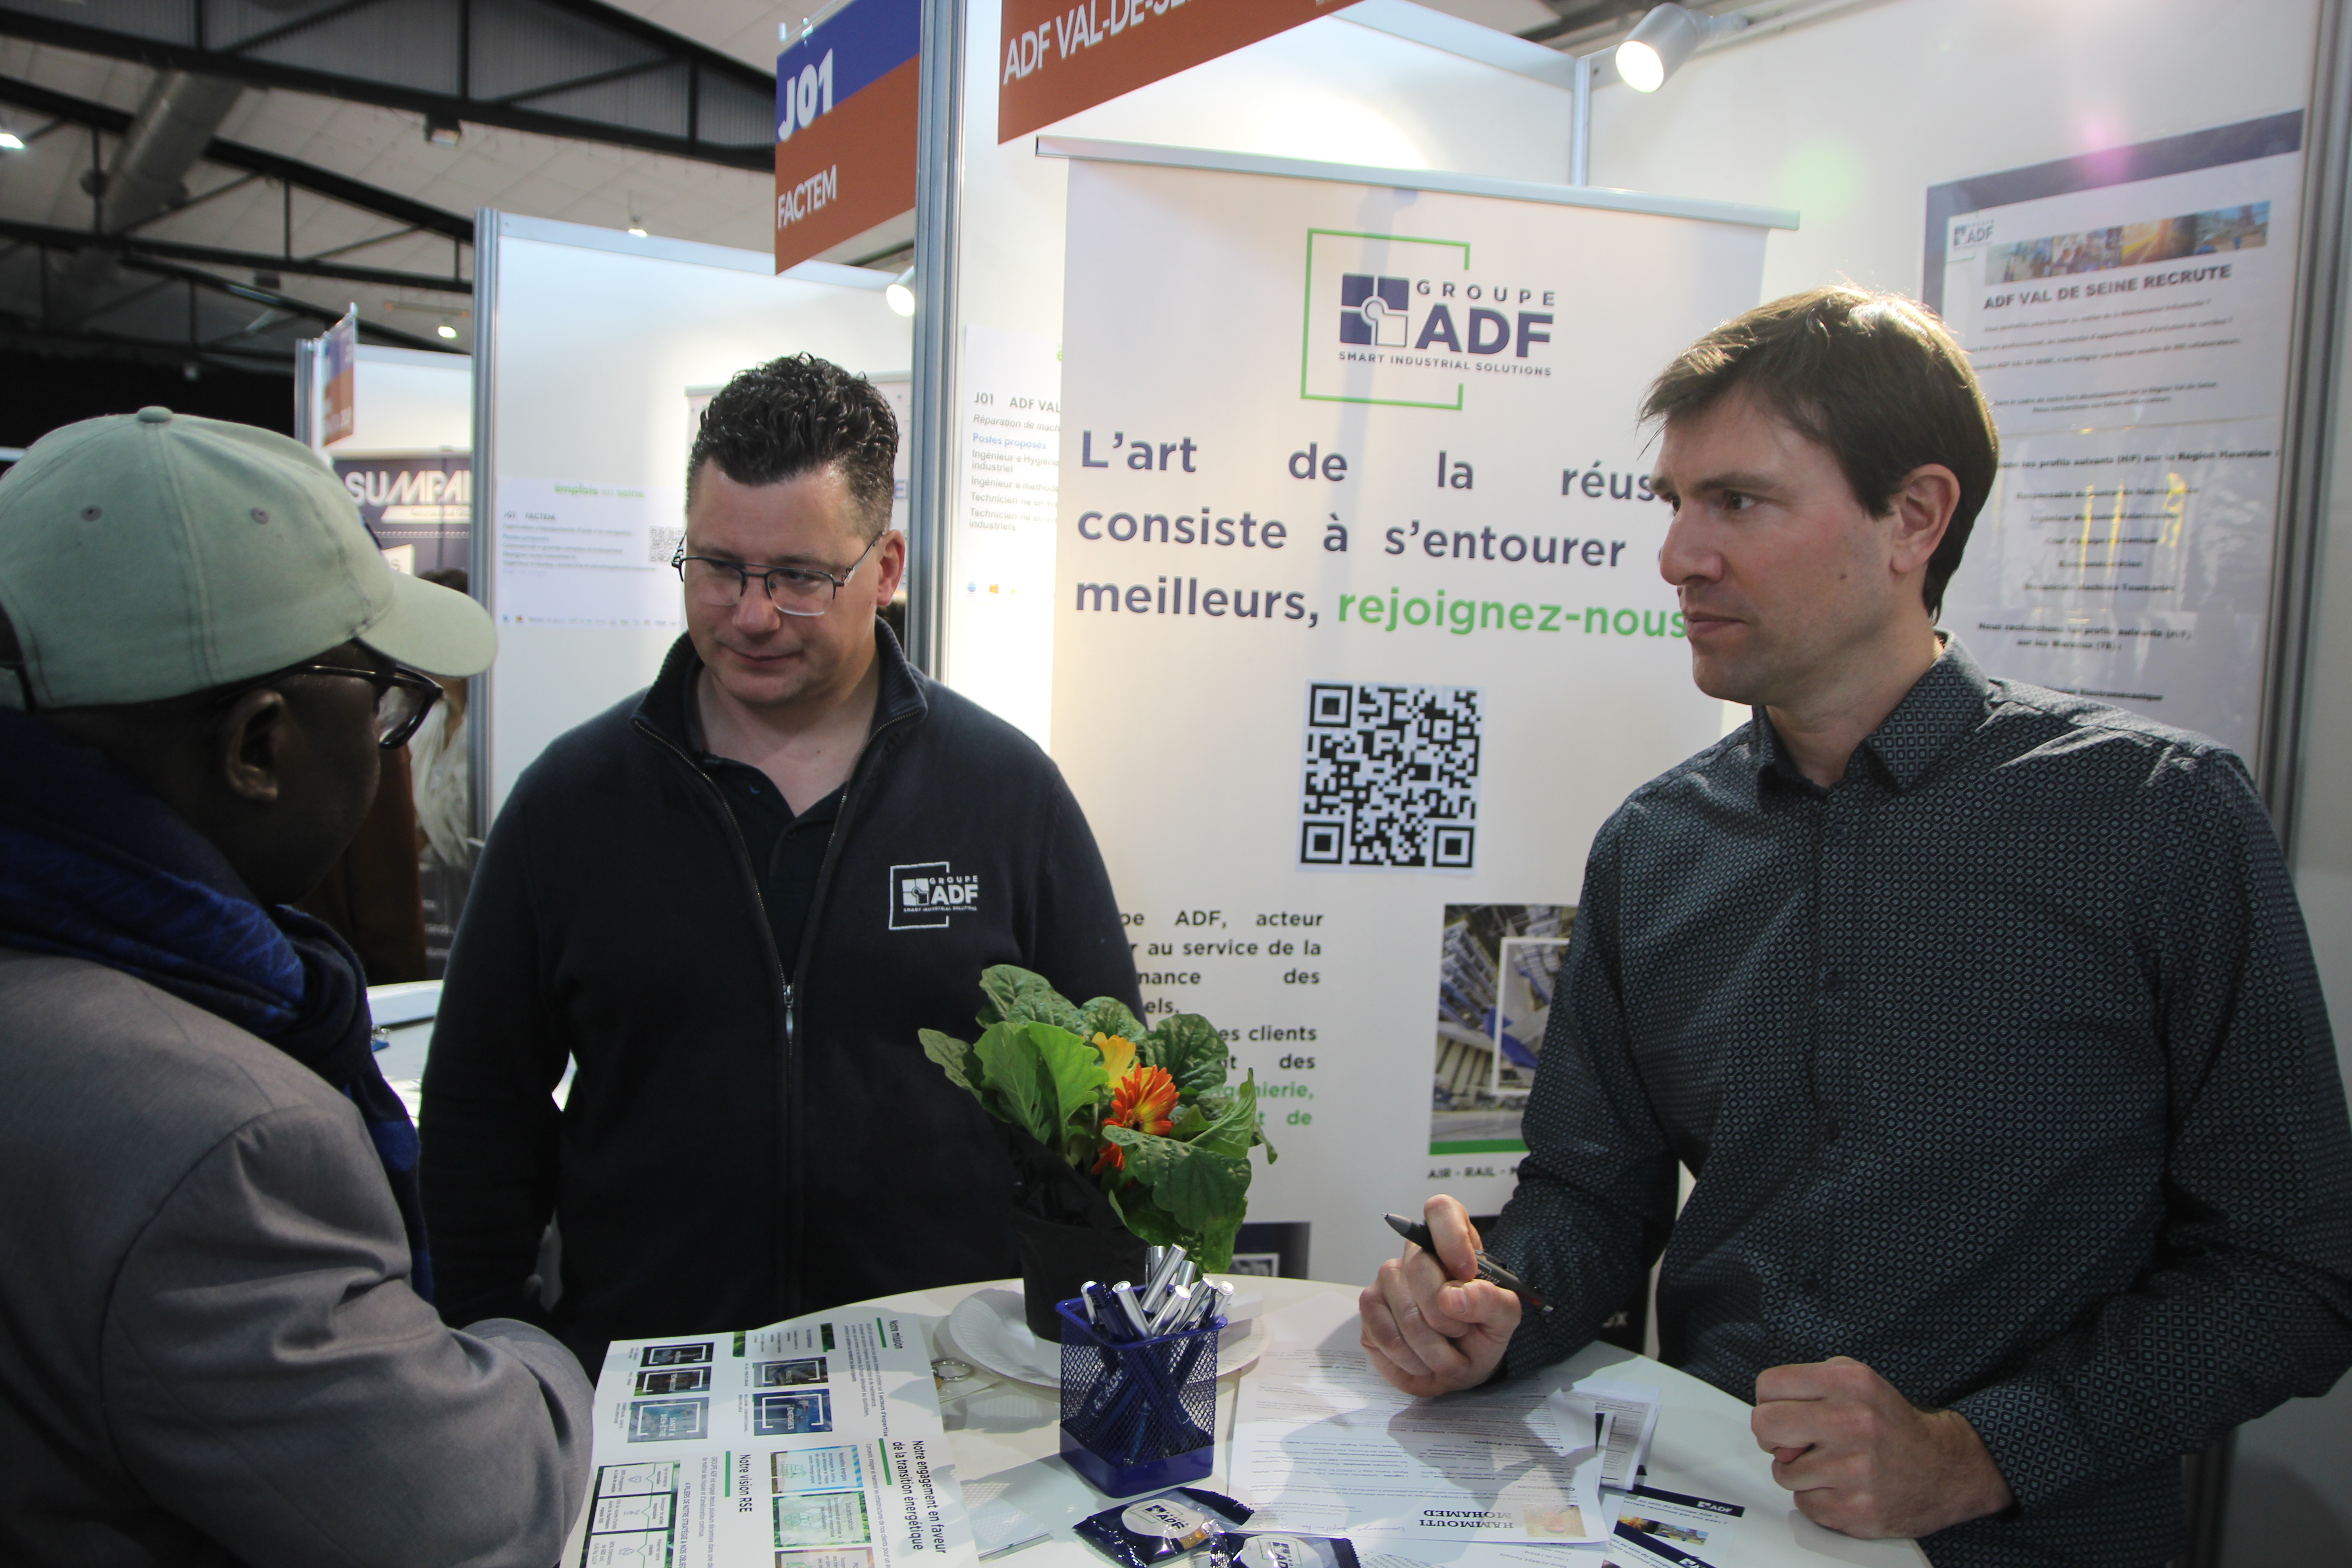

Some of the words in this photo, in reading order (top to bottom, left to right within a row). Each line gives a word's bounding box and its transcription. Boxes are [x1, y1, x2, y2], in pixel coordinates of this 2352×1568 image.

[1003, 20, 1051, 84] ADF
[1056, 0, 1192, 59] VAL-DE-
[778, 48, 833, 142] J01
[777, 164, 836, 230] FACTEM
[1967, 224, 1994, 244] ADF
[1416, 279, 1555, 306] GROUPE
[1983, 294, 2016, 309] ADF
[2019, 289, 2052, 304] VAL
[2058, 285, 2081, 300] DE
[2086, 278, 2139, 296] SEINE
[2143, 263, 2233, 289] RECRUTE
[1414, 302, 1554, 358] ADF
[1339, 351, 1385, 363] SMART
[1391, 355, 1470, 370] INDUSTRIAL
[1476, 362, 1552, 376] SOLUTIONS
[974, 392, 994, 405] J01
[1009, 396, 1034, 410] ADF
[972, 413, 1021, 428] Réparation
[1023, 419, 1034, 429] de
[972, 432, 1002, 445] Postes
[1004, 438, 1046, 450] proposés
[1082, 429, 1198, 473] L'art
[1289, 442, 1348, 481] de
[1437, 450, 1474, 490] la
[2178, 451, 2216, 462] Région
[971, 460, 1013, 472] industriel
[1078, 506, 1287, 549] consiste
[1323, 512, 1348, 552] à
[1385, 520, 1626, 567] s'entourer
[1076, 575, 1318, 628] meilleurs,
[1338, 587, 1687, 638] rejoignez-nous
[929, 875, 978, 885] GROUPE
[931, 884, 979, 906] ADF
[1175, 910, 1226, 928] ADF,
[1255, 911, 1324, 927] acteur
[1147, 941, 1173, 955] au
[1183, 940, 1259, 955] service
[1268, 940, 1294, 955] de
[1304, 939, 1322, 955] la
[1284, 968, 1321, 984] des
[1249, 1025, 1318, 1042] clients
[1279, 1053, 1316, 1069] des
[1286, 1109, 1313, 1126] de
[1426, 1167, 1452, 1179] AIR
[1463, 1166, 1497, 1178] RAIL
[893, 1442, 906, 1450] de
[912, 1441, 926, 1460] Notre
[739, 1454, 752, 1473] Notre
[739, 1475, 753, 1495] vision
[896, 1460, 913, 1494] transition
[916, 1461, 939, 1509] engagement
[739, 1497, 753, 1513] RSE
[1710, 1504, 1733, 1513] ADF
[845, 1502, 854, 1531] Décarbonation
[903, 1497, 924, 1550] énergétique
[928, 1511, 940, 1522] en
[1157, 1513, 1186, 1530] ADF
[1423, 1510, 1512, 1519] MOHAMED
[681, 1518, 689, 1540] STRATÉGIE
[1419, 1519, 1514, 1529] HAMMOUTI
[881, 1534, 889, 1547] clients
[931, 1524, 946, 1553] faveur
[881, 1548, 889, 1557] pour
